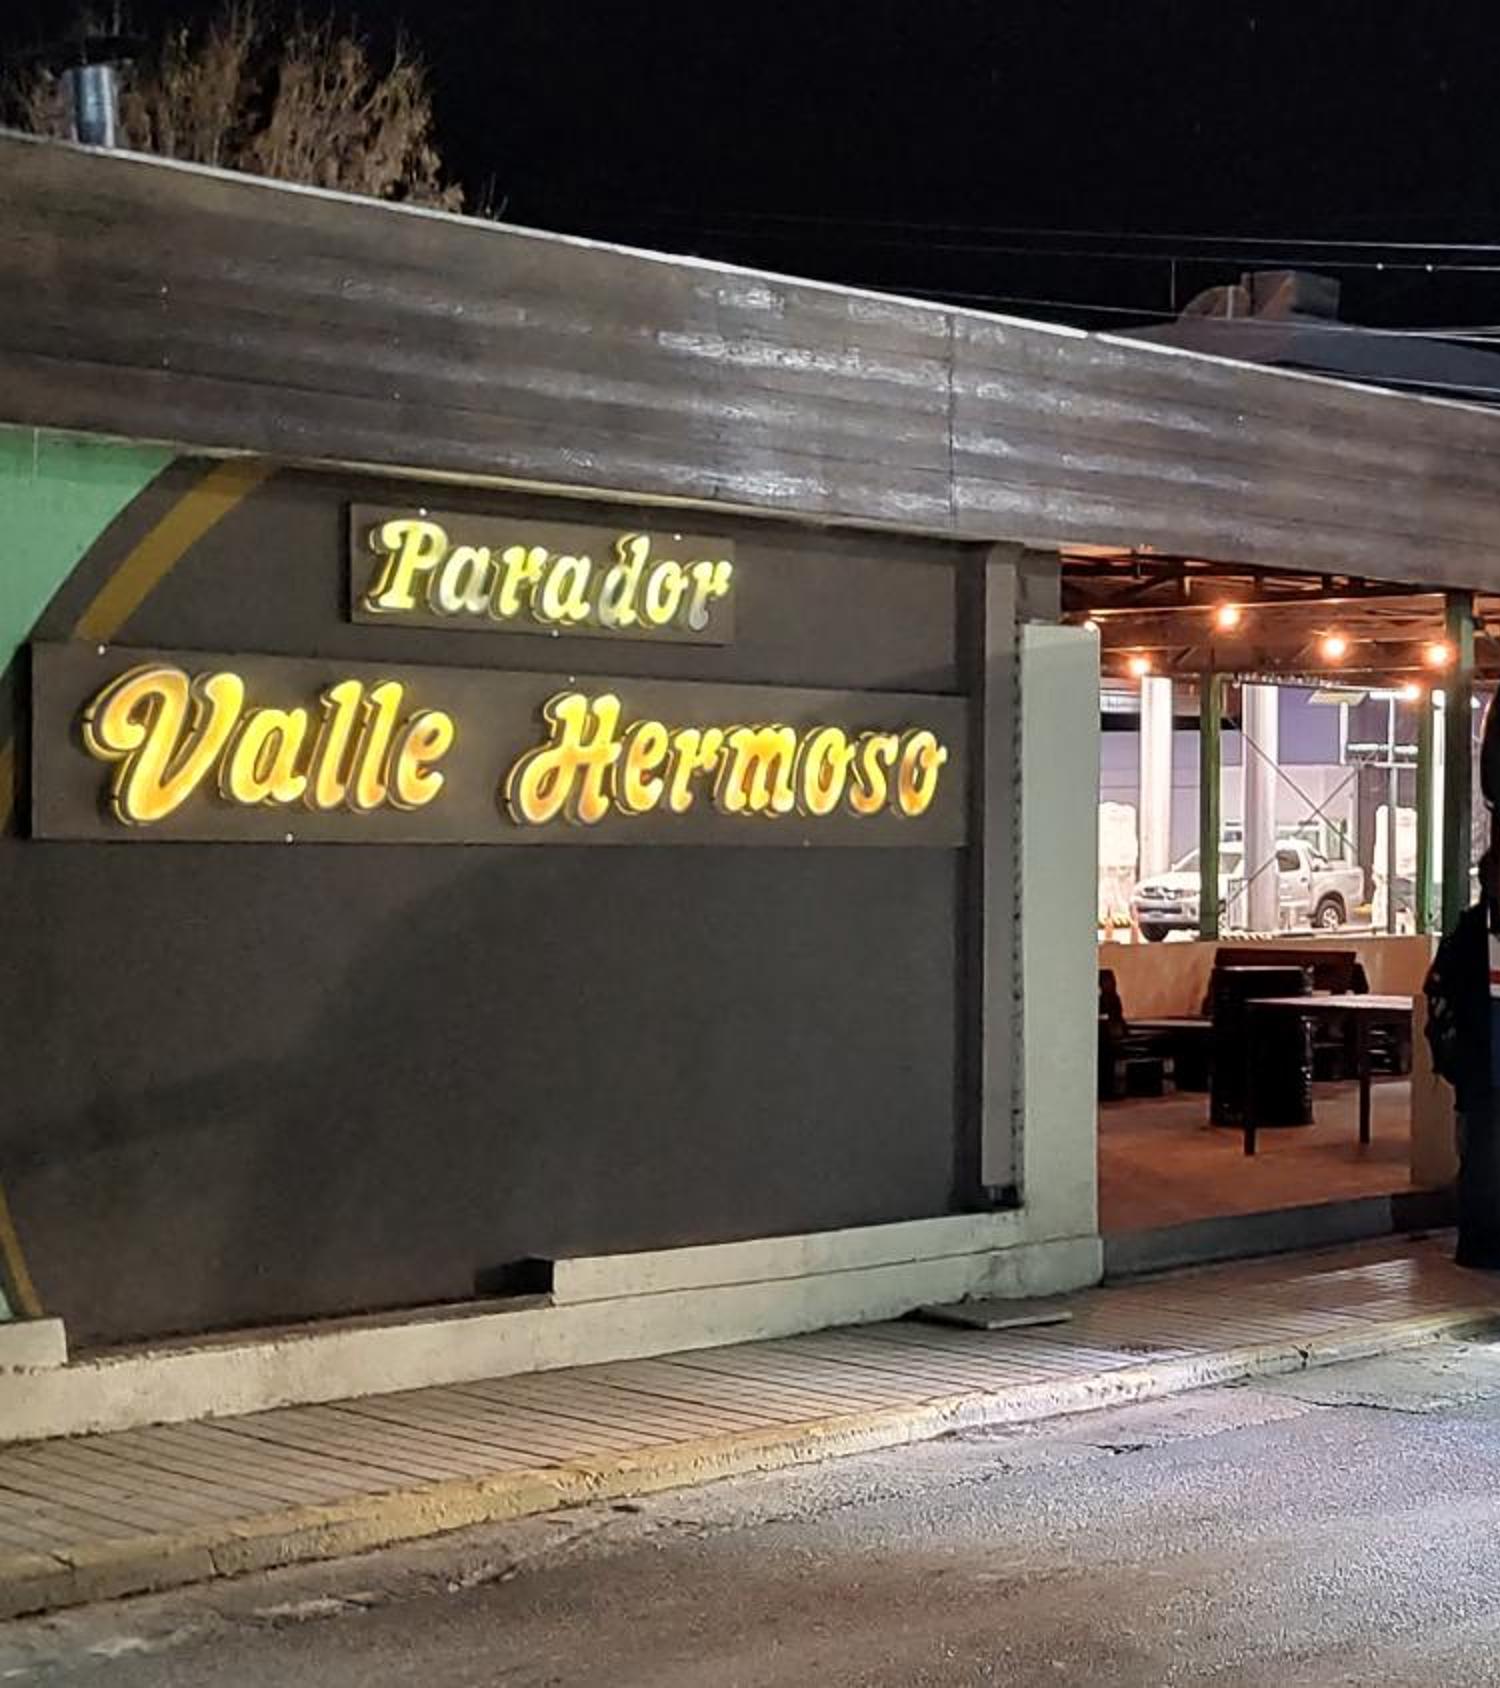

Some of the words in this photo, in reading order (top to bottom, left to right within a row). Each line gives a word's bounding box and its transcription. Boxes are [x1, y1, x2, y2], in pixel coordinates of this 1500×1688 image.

[366, 516, 734, 631] Parador
[82, 664, 454, 827] Valle
[503, 692, 947, 825] Hermoso
